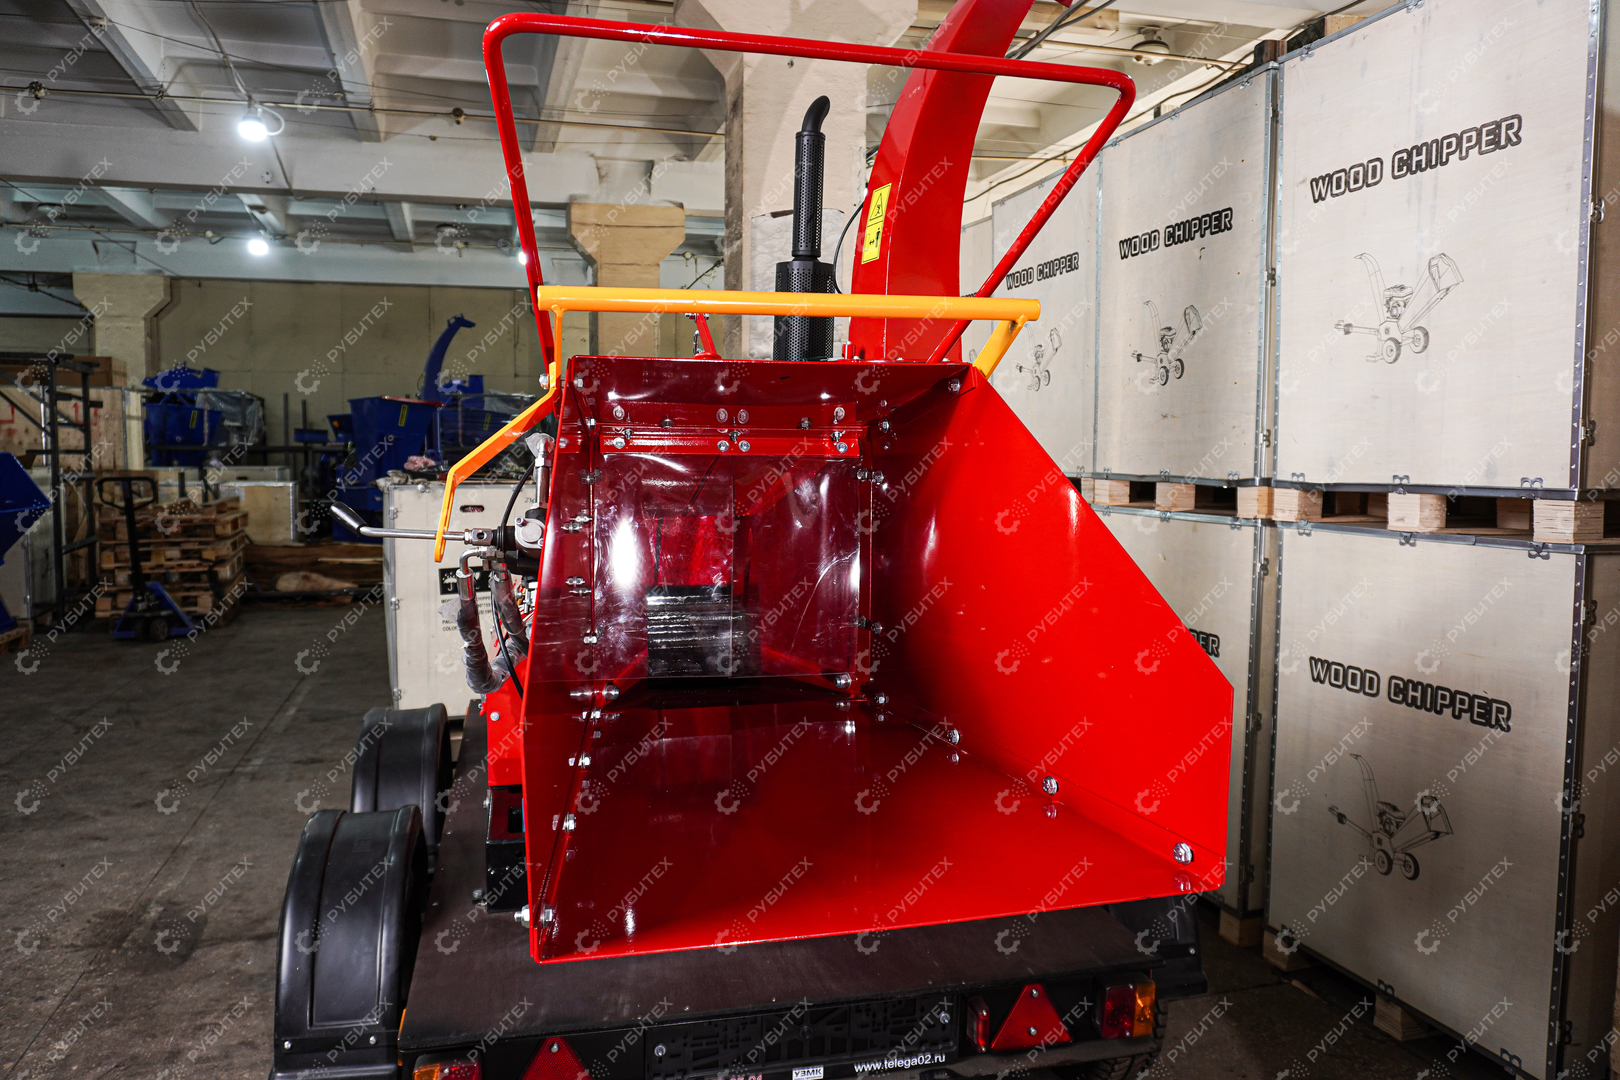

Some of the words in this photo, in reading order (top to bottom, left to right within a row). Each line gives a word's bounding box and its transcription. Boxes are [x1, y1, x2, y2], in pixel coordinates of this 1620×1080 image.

[1310, 157, 1383, 203] WOOD
[1391, 113, 1522, 180] CHIPPER
[1119, 229, 1160, 260] WOOD
[1164, 207, 1233, 247] CHIPPER
[1006, 267, 1034, 290] WOOD
[1037, 252, 1079, 281] CHIPPER
[1309, 656, 1381, 698] WOOD
[1388, 675, 1512, 733] CHIPPER
[794, 1068, 822, 1077] УЗМК
[853, 1053, 946, 1072] www.telega02.ru
